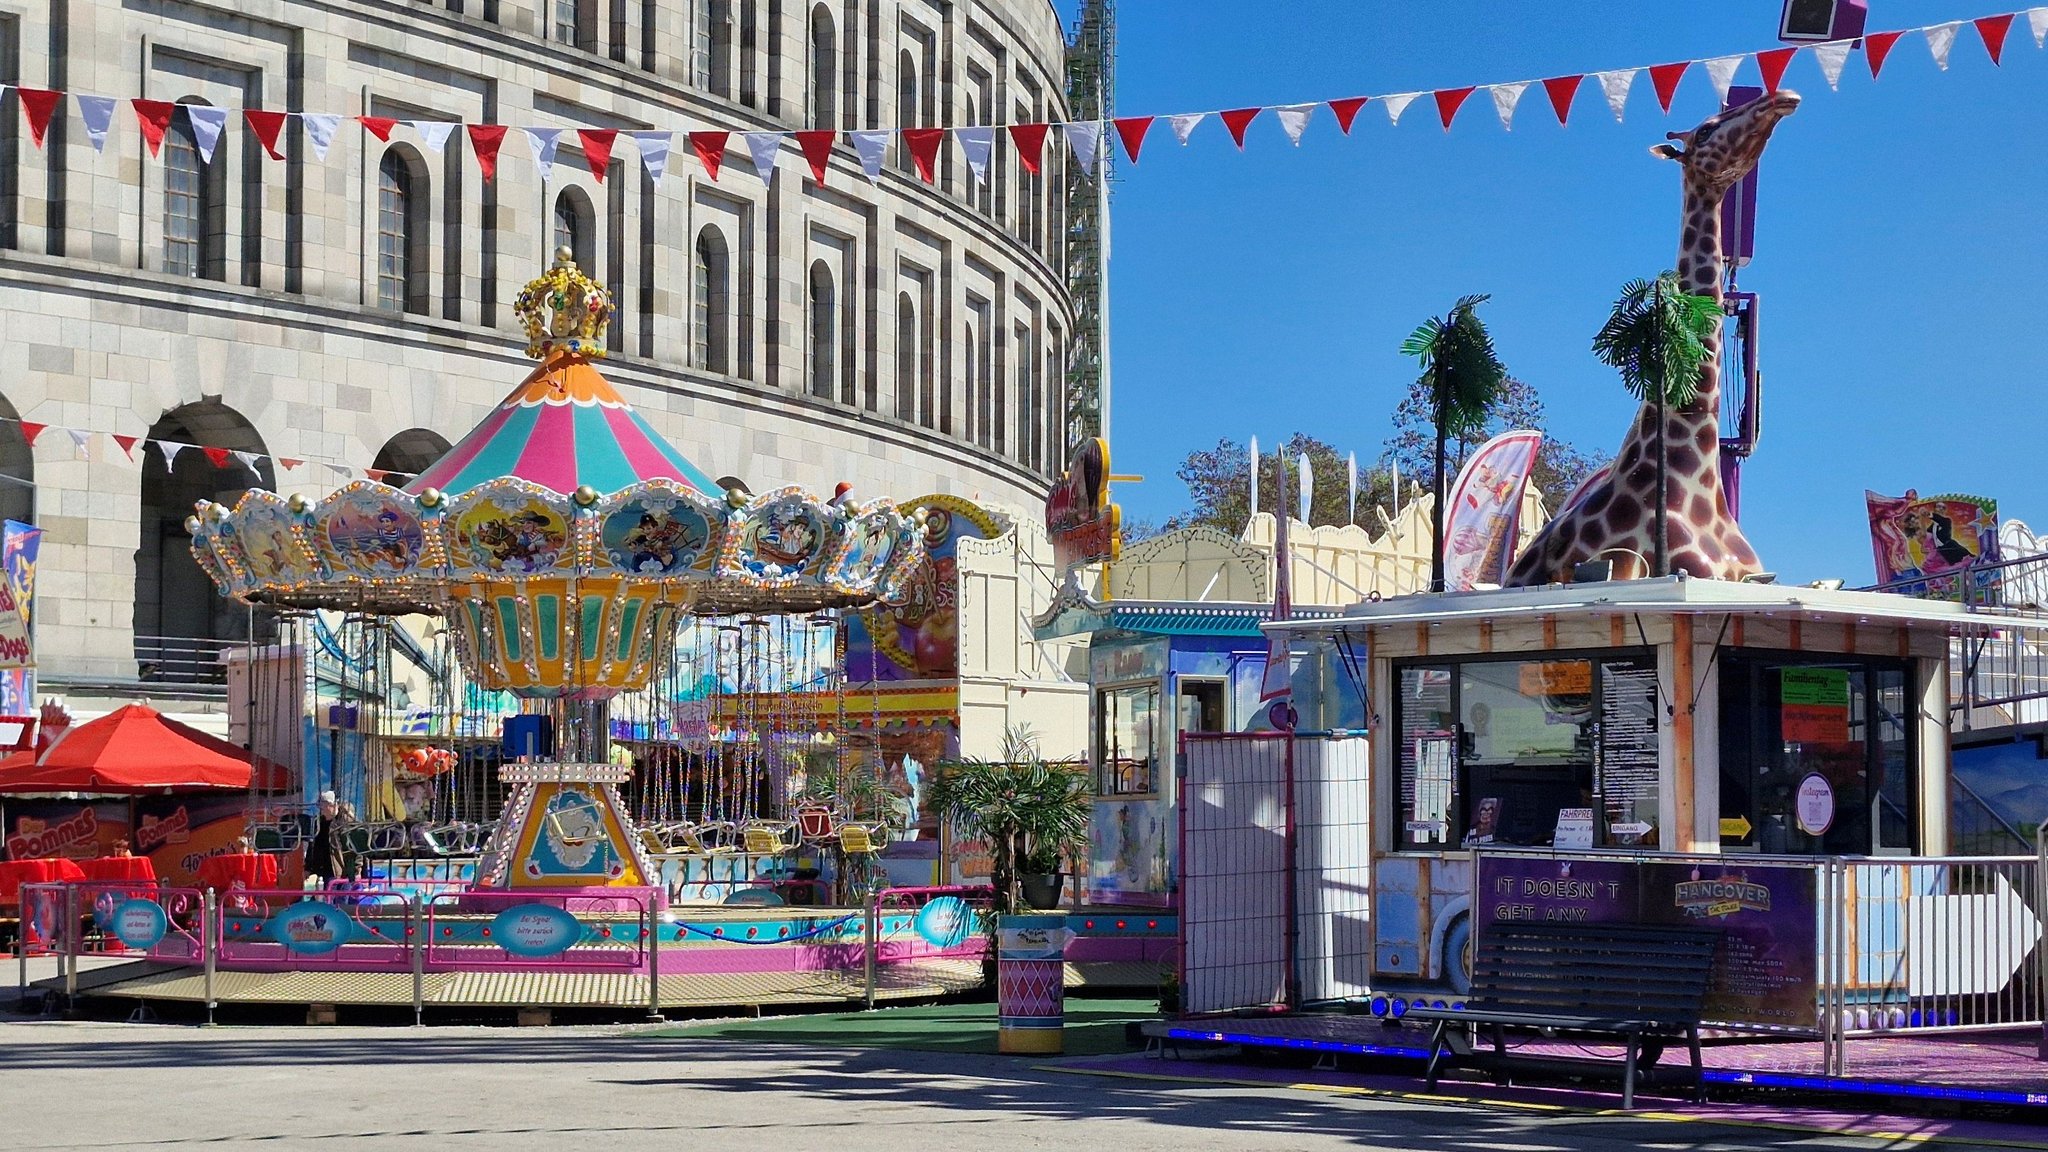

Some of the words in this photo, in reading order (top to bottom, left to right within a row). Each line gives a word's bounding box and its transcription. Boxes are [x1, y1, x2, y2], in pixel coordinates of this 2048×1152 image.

[1496, 876, 1513, 895] IT
[1678, 883, 1769, 904] HANGOVER
[1495, 904, 1535, 921] GET
[1545, 905, 1588, 922] ANY
[1759, 1008, 1796, 1017] WORLD
